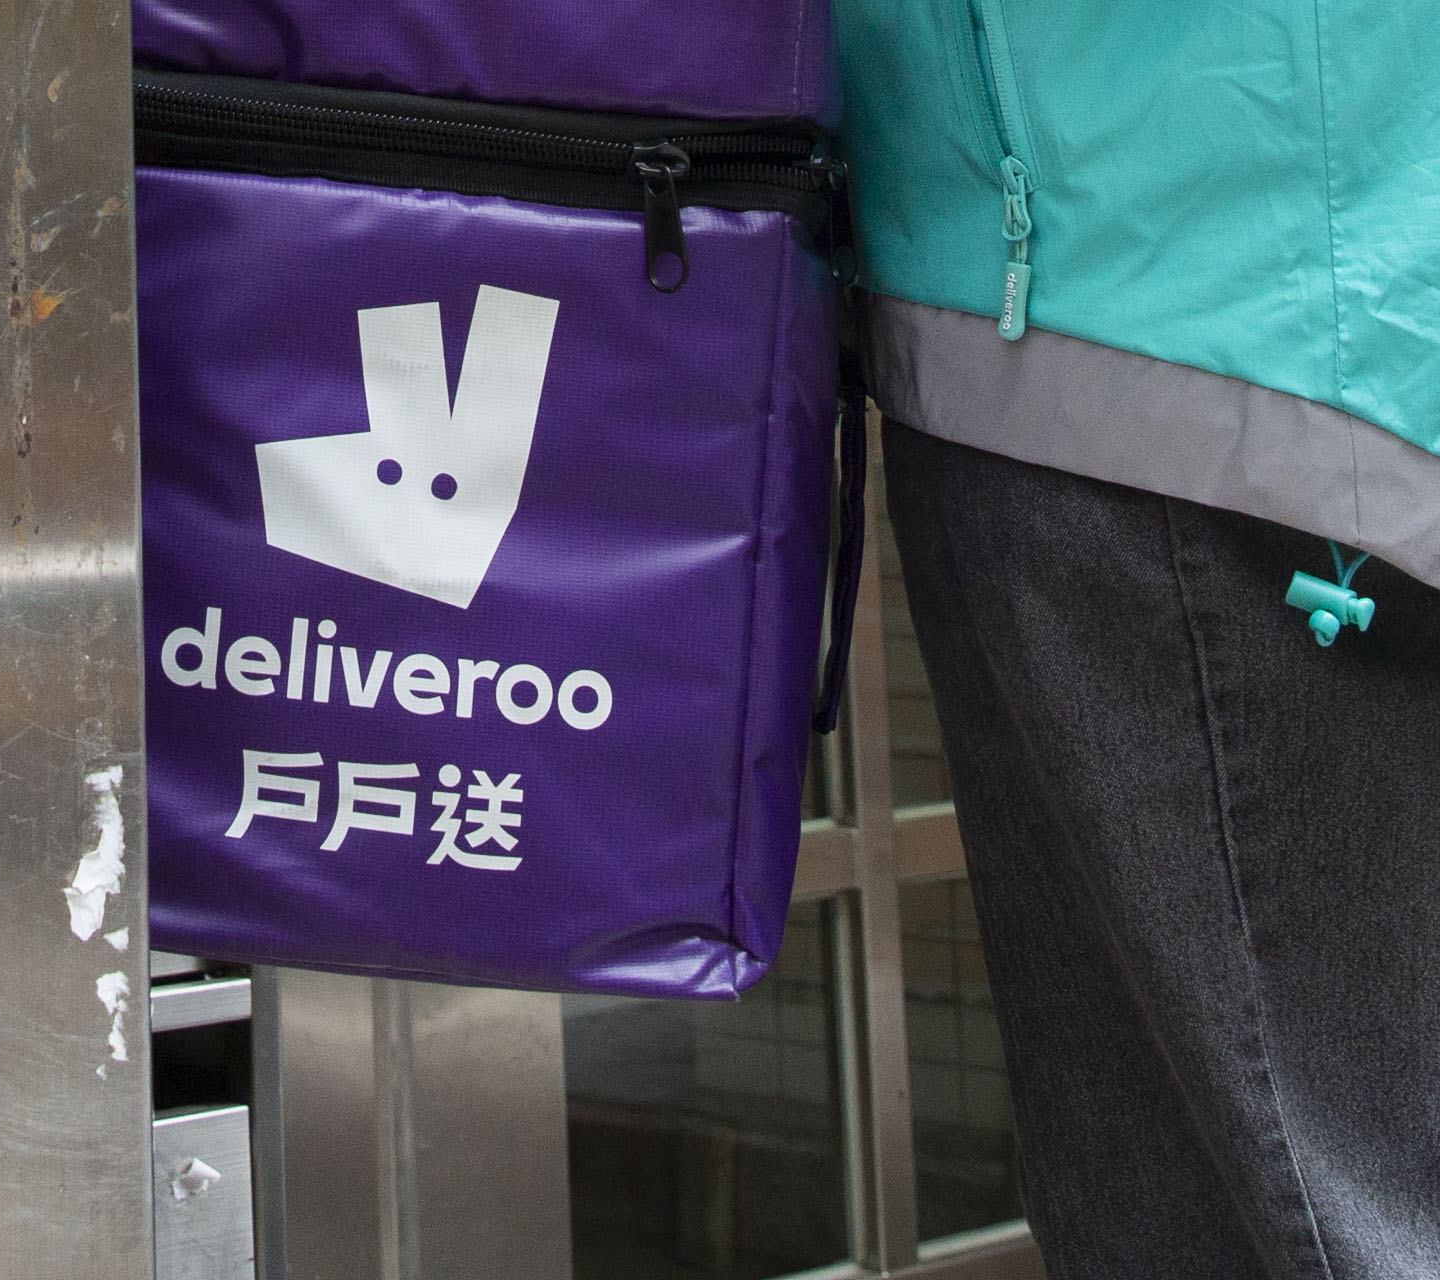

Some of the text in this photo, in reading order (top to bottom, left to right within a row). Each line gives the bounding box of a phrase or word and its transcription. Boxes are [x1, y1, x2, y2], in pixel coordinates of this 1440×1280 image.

[1002, 273, 1017, 330] deliveroo
[161, 606, 613, 730] deliveroo
[224, 749, 524, 871] 戶戶送
